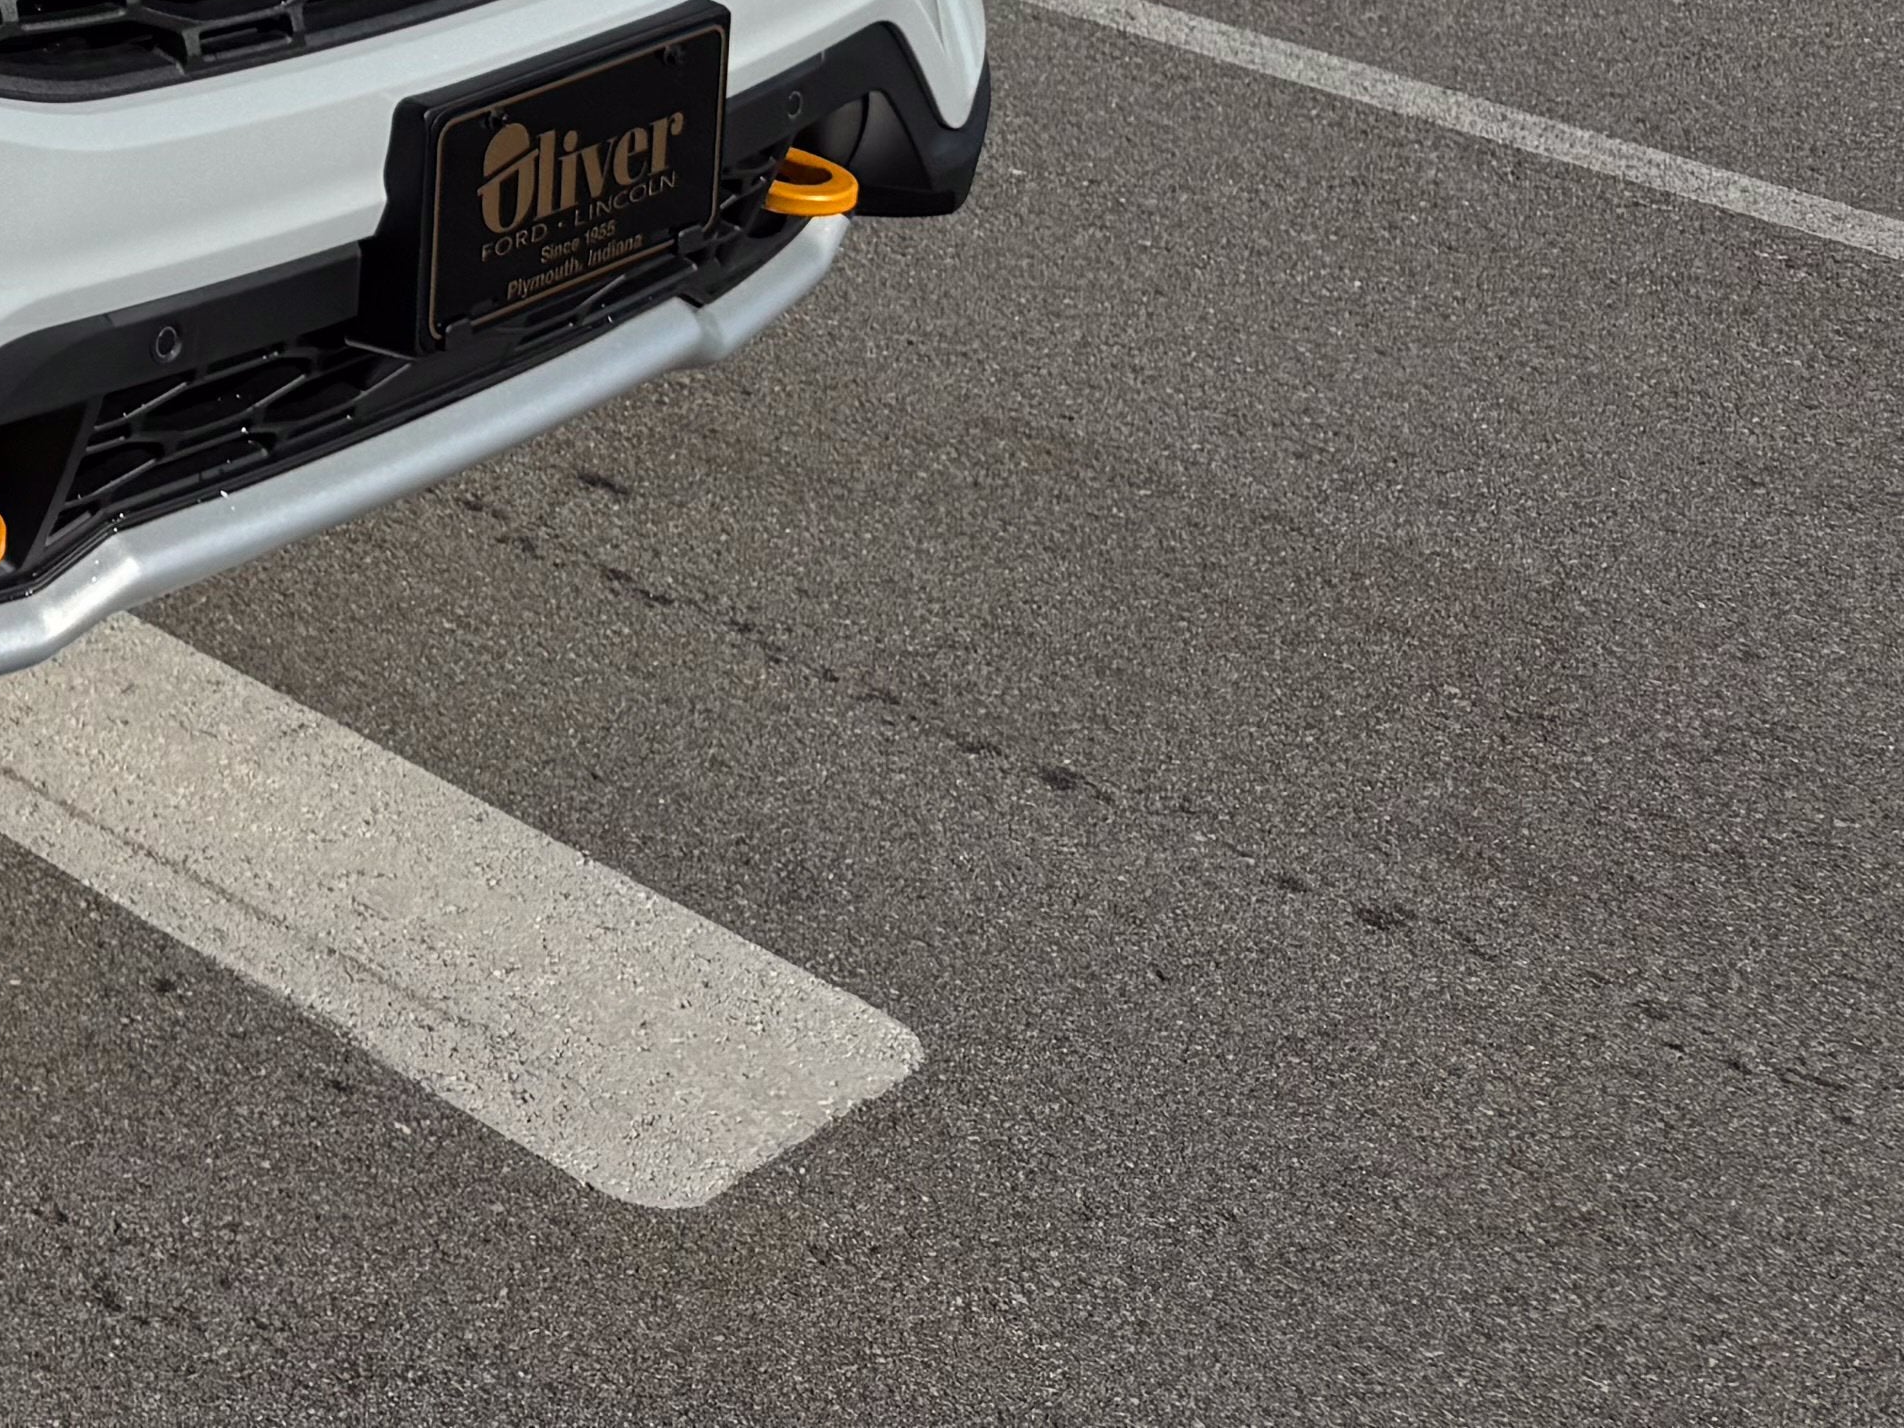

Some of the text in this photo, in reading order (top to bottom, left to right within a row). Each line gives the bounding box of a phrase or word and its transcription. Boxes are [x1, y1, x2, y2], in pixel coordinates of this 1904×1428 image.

[476, 109, 684, 236] Oliver
[480, 170, 679, 262] FORD LINCOLN
[540, 219, 617, 266] Since 1955
[506, 233, 644, 302] Plymouth, Indiana
